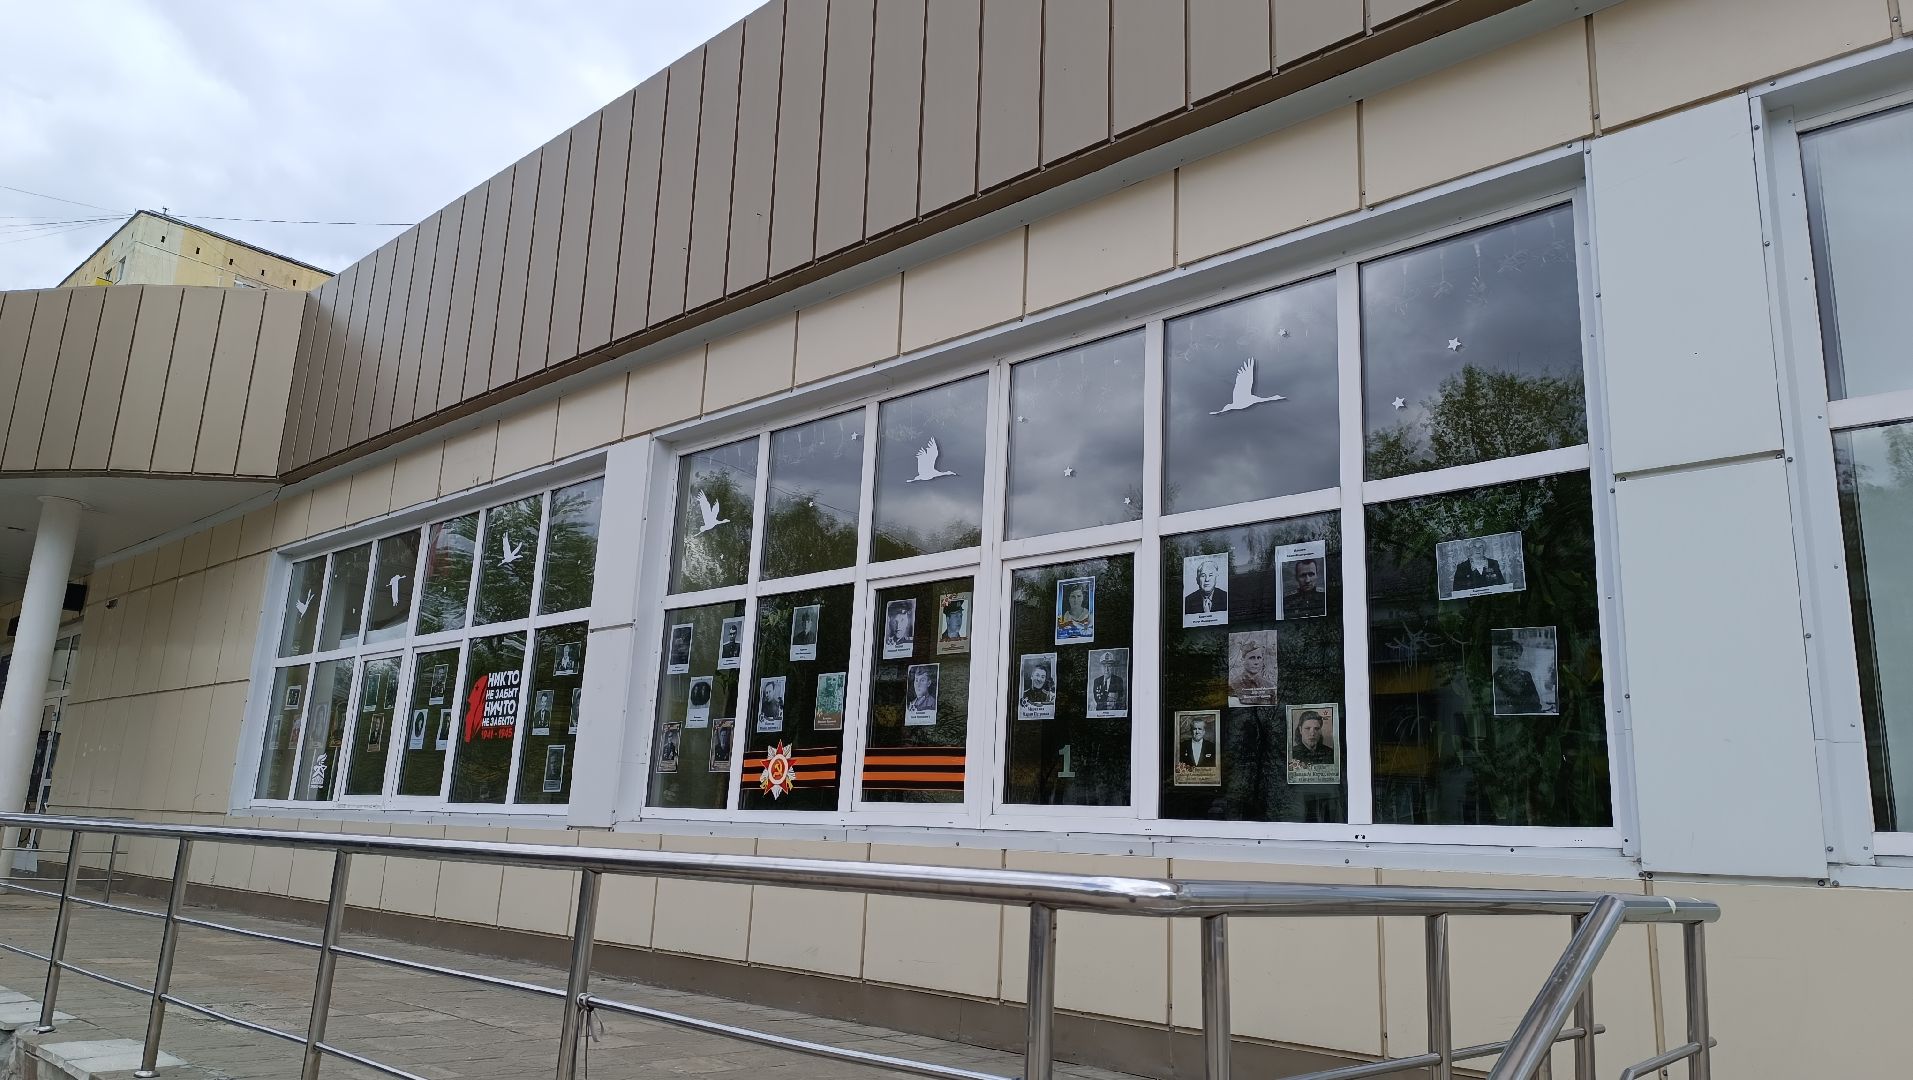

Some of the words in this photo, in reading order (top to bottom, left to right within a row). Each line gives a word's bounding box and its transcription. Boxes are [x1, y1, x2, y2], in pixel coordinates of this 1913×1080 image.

[488, 670, 519, 687] НИКТО
[486, 690, 494, 700] НЕ
[495, 688, 518, 700] ЗАБЫТ
[484, 700, 516, 716] НИЧТО
[482, 718, 490, 727] НЕ
[490, 716, 514, 726] ЗАБЫТО
[481, 729, 494, 739] 1941
[498, 728, 513, 739] 1945
[1057, 744, 1076, 778] 1
